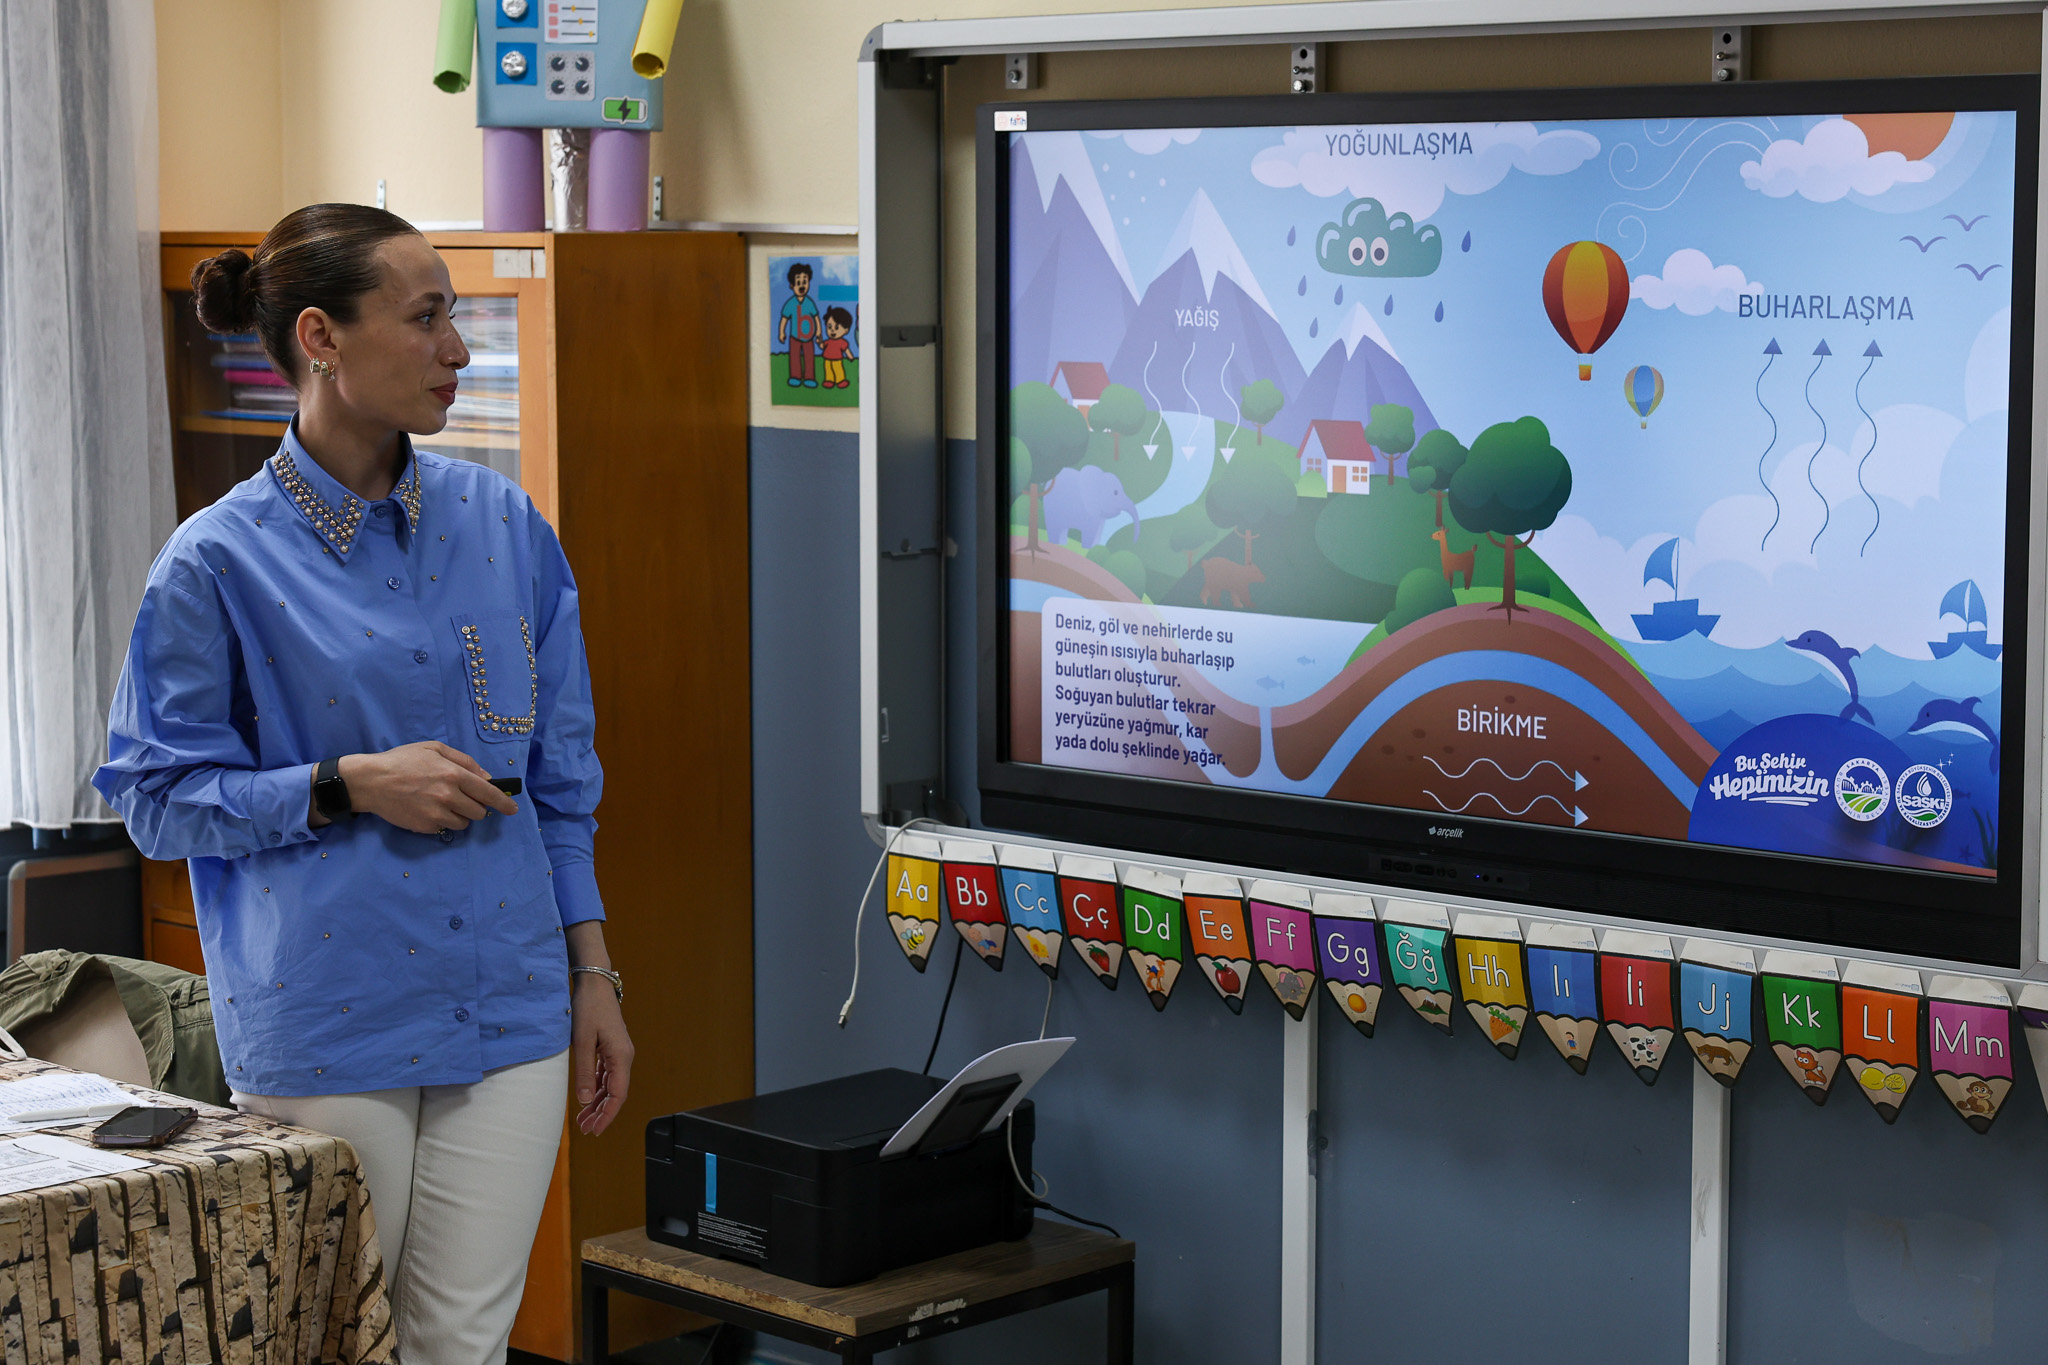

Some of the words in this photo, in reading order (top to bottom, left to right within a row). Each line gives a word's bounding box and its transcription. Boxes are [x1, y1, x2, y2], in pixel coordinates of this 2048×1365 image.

[1325, 128, 1473, 161] YOĞUNLAŞMA
[1175, 305, 1219, 332] YAĞIŞ
[1738, 294, 1914, 327] BUHARLAŞMA
[1055, 613, 1096, 634] Deniz,
[1099, 618, 1120, 637] göl
[1123, 622, 1139, 635] ve
[1142, 622, 1213, 642] nehirlerde
[1216, 630, 1233, 644] su
[1055, 637, 1108, 657] güneşin
[1111, 644, 1158, 664] ısısıyla
[1161, 646, 1235, 671] buharlaşıp
[1055, 661, 1111, 681] bulutları
[1114, 667, 1181, 688] oluşturur.
[1055, 685, 1113, 706] Soğuyan
[1116, 690, 1169, 711] bulutlar
[1172, 698, 1216, 716] tekrar
[1055, 708, 1124, 731] yeryüzüne
[1127, 718, 1182, 738] yağmur,
[1186, 722, 1209, 739] kar
[1457, 704, 1547, 740] BİRİKME
[1055, 733, 1087, 751] yada
[1090, 736, 1119, 754] dolu
[1122, 741, 1180, 761] şeklinde
[1183, 748, 1226, 768] yağar.
[1735, 755, 1758, 772] Bu
[1760, 752, 1806, 775] Şehir
[1846, 759, 1880, 773] SAKARYA
[1709, 768, 1830, 801] Hepimizin
[1436, 827, 1464, 838] arçelik
[896, 870, 929, 902] Aa
[956, 876, 989, 907] Bb
[1014, 883, 1049, 914] Cc
[1072, 893, 1110, 930] Çç
[1134, 904, 1171, 941] Dd
[1199, 909, 1234, 941] Ee
[1265, 917, 1298, 951] Ff
[1327, 932, 1371, 977] Gg
[1396, 932, 1439, 985] Ğğ
[1468, 952, 1510, 988] Hh
[1698, 983, 1731, 1031] Jj
[1782, 992, 1821, 1029] Kk
[1863, 1004, 1895, 1044] Ll
[1934, 1016, 2004, 1058] Mm
